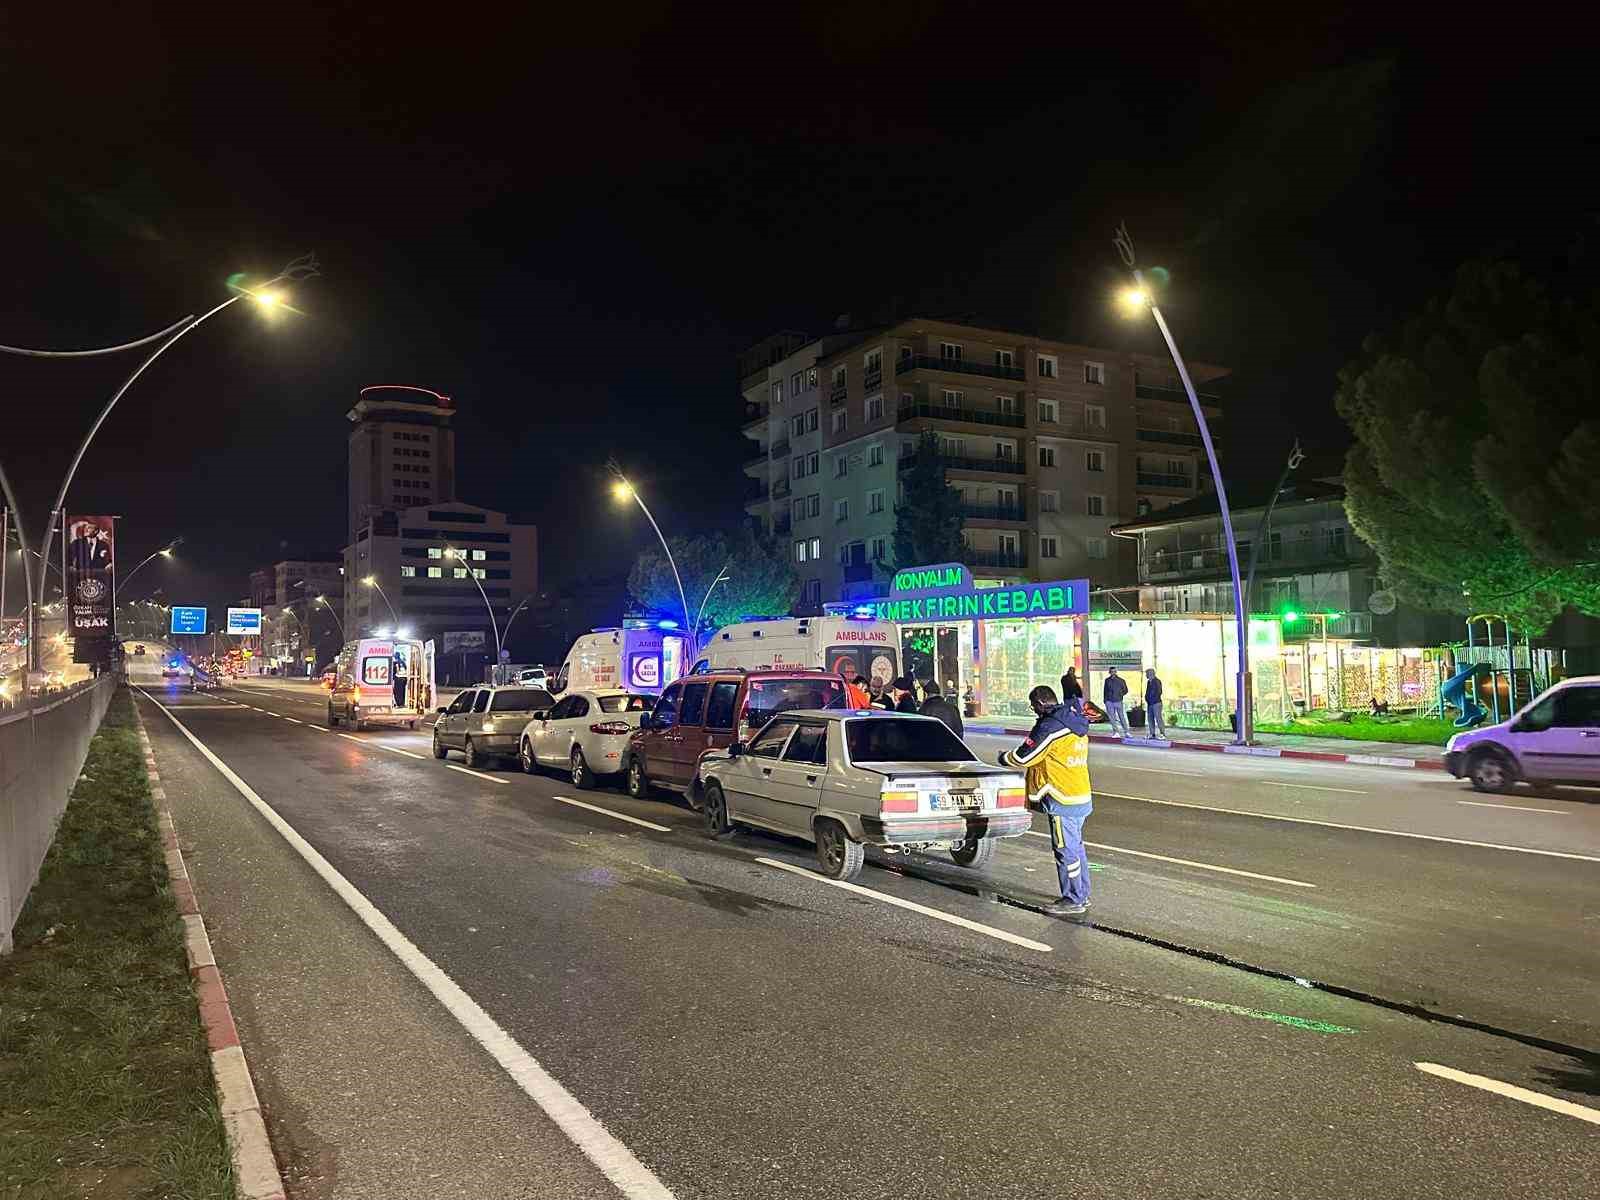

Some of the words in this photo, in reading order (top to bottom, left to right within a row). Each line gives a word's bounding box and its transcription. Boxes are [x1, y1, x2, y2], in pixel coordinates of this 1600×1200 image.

[895, 567, 962, 591] KONYALIM
[925, 595, 979, 618] FIRIN
[982, 586, 1074, 614] KEBABI
[75, 617, 109, 629] UŞAK
[835, 631, 887, 641] AMBULANS
[366, 665, 388, 680] 112
